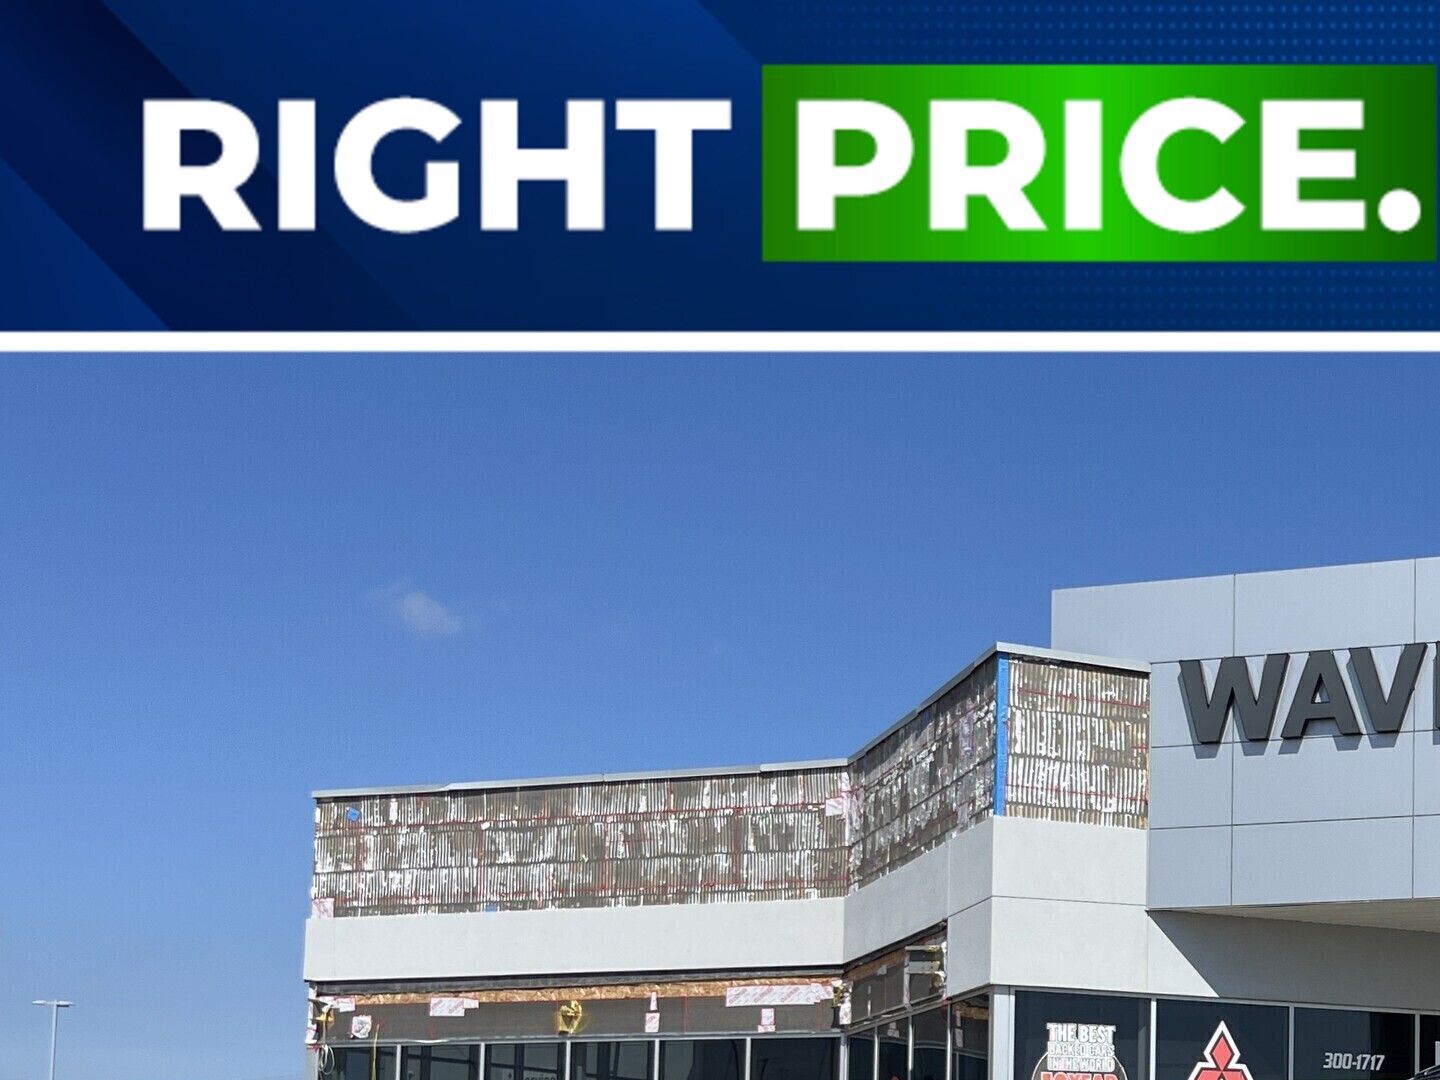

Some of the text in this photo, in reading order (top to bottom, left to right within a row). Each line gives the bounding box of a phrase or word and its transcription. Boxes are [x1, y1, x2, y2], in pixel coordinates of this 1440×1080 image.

[1046, 1023, 1116, 1045] THE BEST
[1048, 1043, 1115, 1057] BACKED CARS
[1049, 1057, 1116, 1071] IN THE WORLD
[1323, 1052, 1385, 1071] 300-1717
